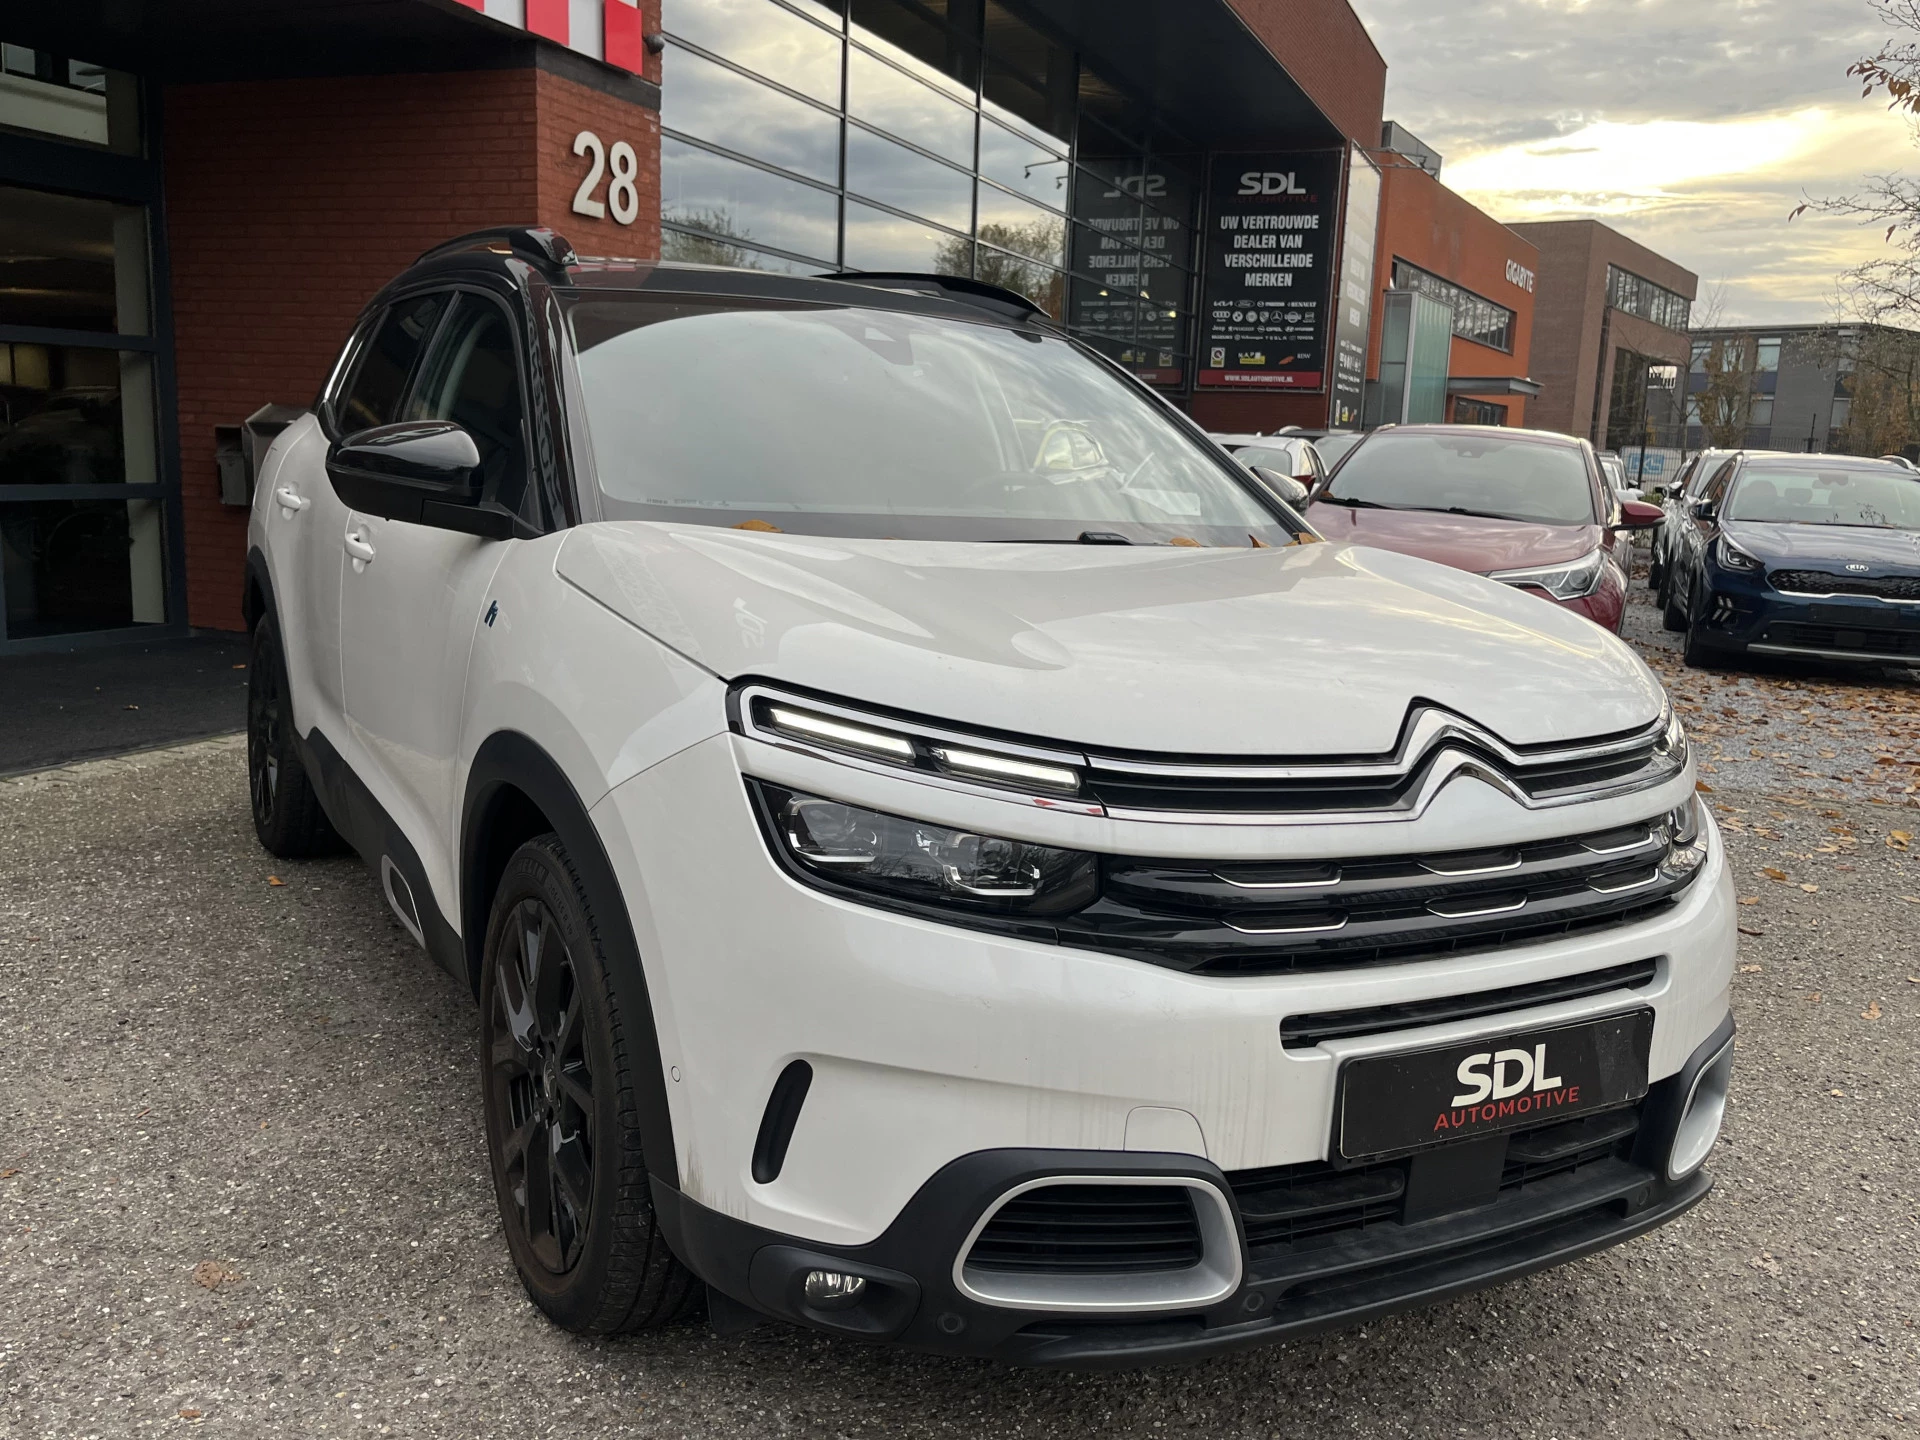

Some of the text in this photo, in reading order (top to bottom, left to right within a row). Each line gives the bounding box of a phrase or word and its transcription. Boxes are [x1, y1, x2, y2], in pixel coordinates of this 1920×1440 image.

[571, 130, 639, 226] 28
[1237, 172, 1306, 195] SDL
[1220, 215, 1319, 230] UW VERTROUWDE
[1233, 234, 1303, 249] DEALER VAN
[1224, 253, 1313, 268] VERSCHILLENDE
[1244, 273, 1293, 288] MERKEN
[1505, 258, 1535, 294] GIGABYTE
[1450, 1043, 1563, 1108] SDL
[1433, 1085, 1580, 1132] AUTOMOTIVE
